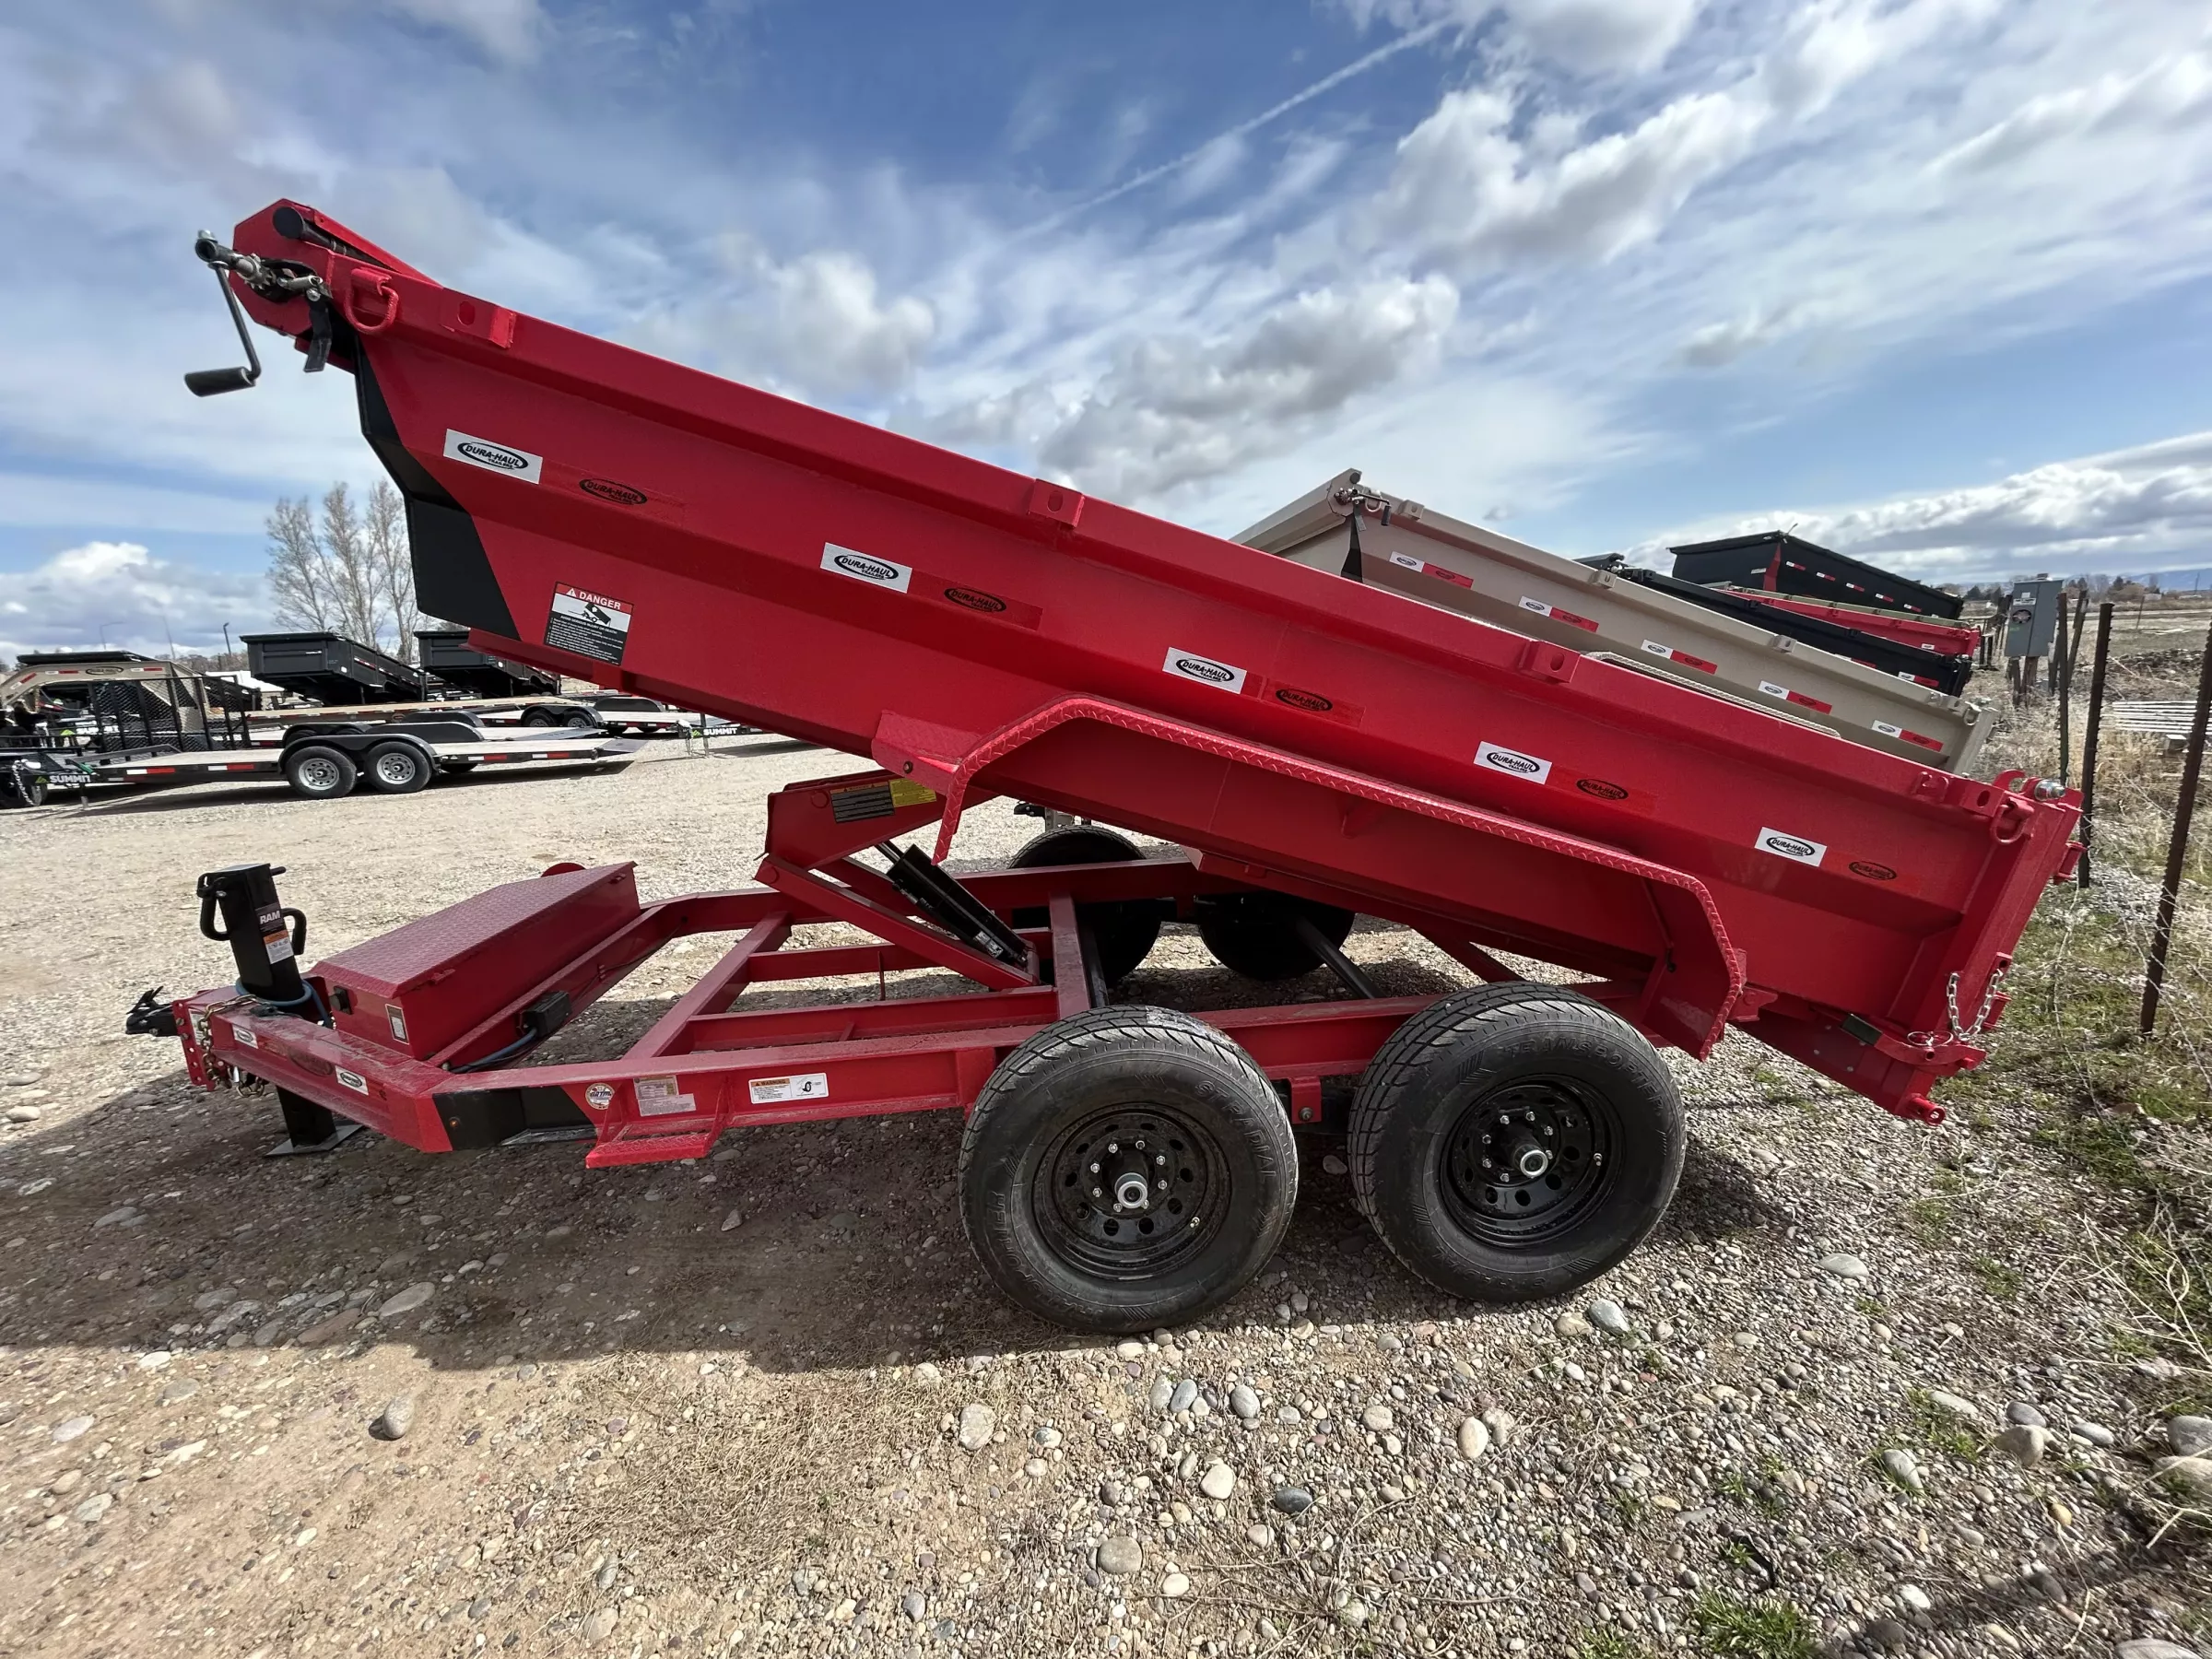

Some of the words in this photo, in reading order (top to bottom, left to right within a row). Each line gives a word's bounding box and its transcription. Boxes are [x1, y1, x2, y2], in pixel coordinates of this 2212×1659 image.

[465, 444, 520, 466] DURA-HAUL
[585, 480, 639, 501] DURA-HAUL
[841, 557, 890, 577] DURA-HAUL
[579, 591, 621, 610] DANGER
[951, 590, 1000, 609] DURA-HAUL
[1182, 661, 1227, 679] DURA-HAUL
[1281, 690, 1325, 709] DURA-HAUL
[703, 727, 737, 735] SUMMIT
[1492, 753, 1534, 771] DURA-HAUL
[1582, 781, 1622, 797] DURA-HAUL
[1771, 839, 1808, 853] DURA-HAUL
[259, 910, 281, 924] RAM
[1504, 1037, 1665, 1112] TRANSPORTER
[1195, 1080, 1230, 1103] ST
